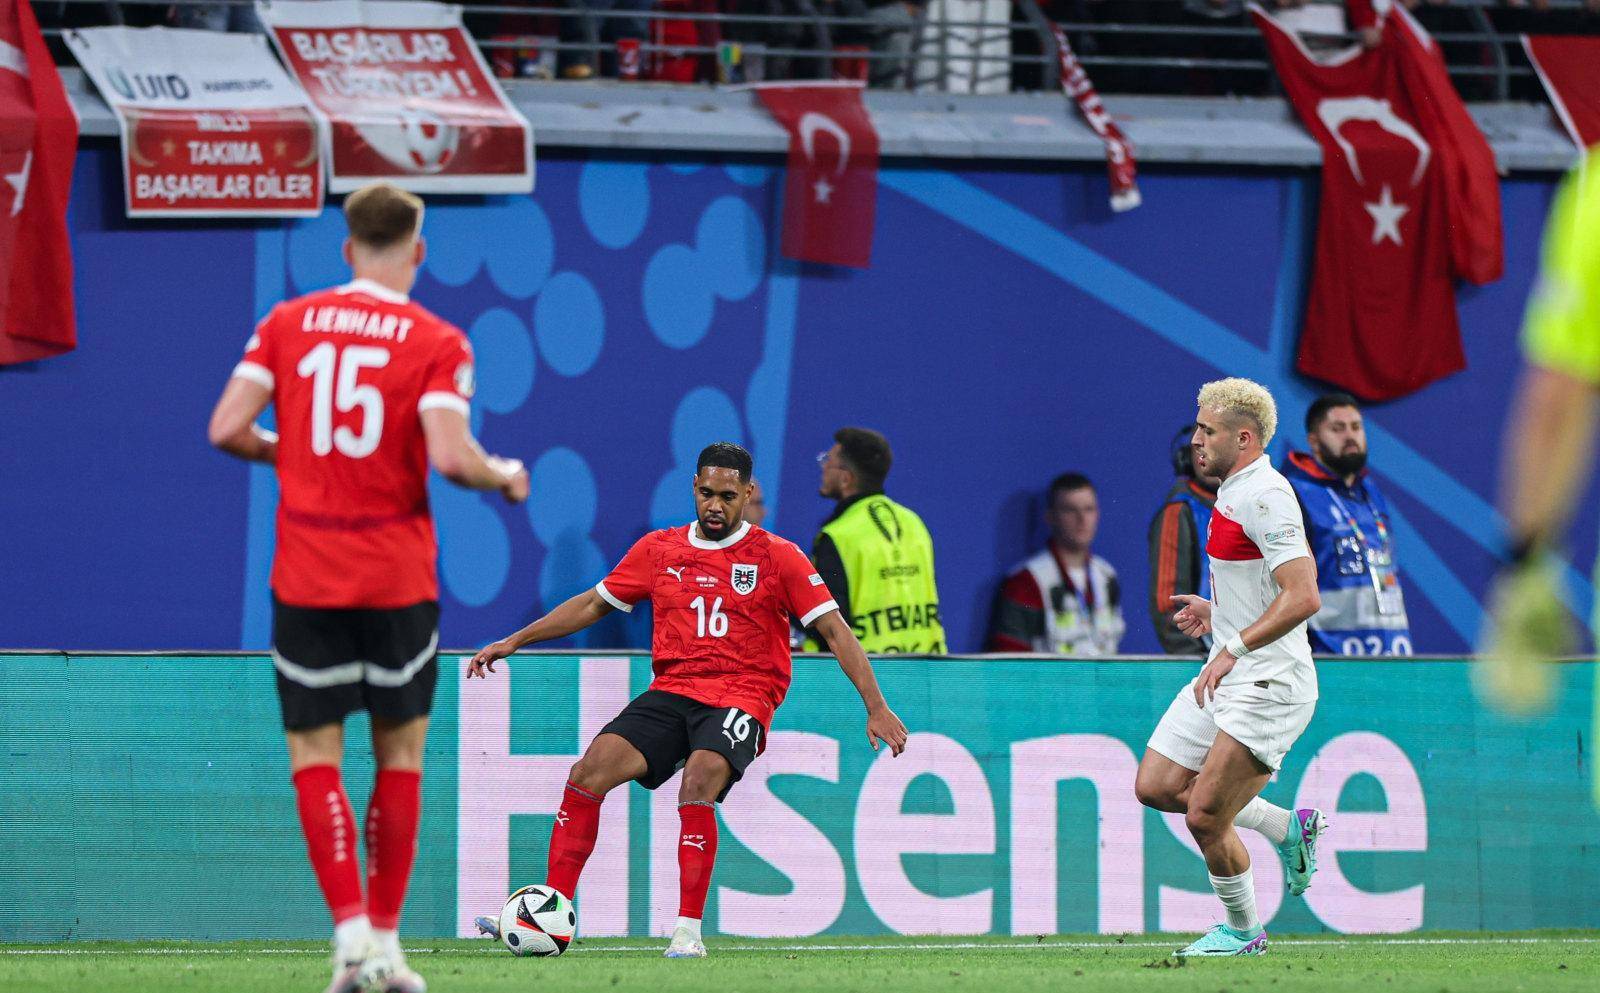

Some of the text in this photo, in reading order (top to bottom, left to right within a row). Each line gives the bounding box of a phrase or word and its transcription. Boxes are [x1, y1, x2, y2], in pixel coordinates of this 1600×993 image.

[187, 141, 263, 165] TAKIMA
[135, 168, 313, 204] BAŞARILAR DİLER
[302, 306, 414, 343] LIENHART
[297, 341, 390, 459] 15
[690, 595, 729, 638] 16
[722, 707, 752, 742] 16
[458, 656, 1426, 938] Hisense
